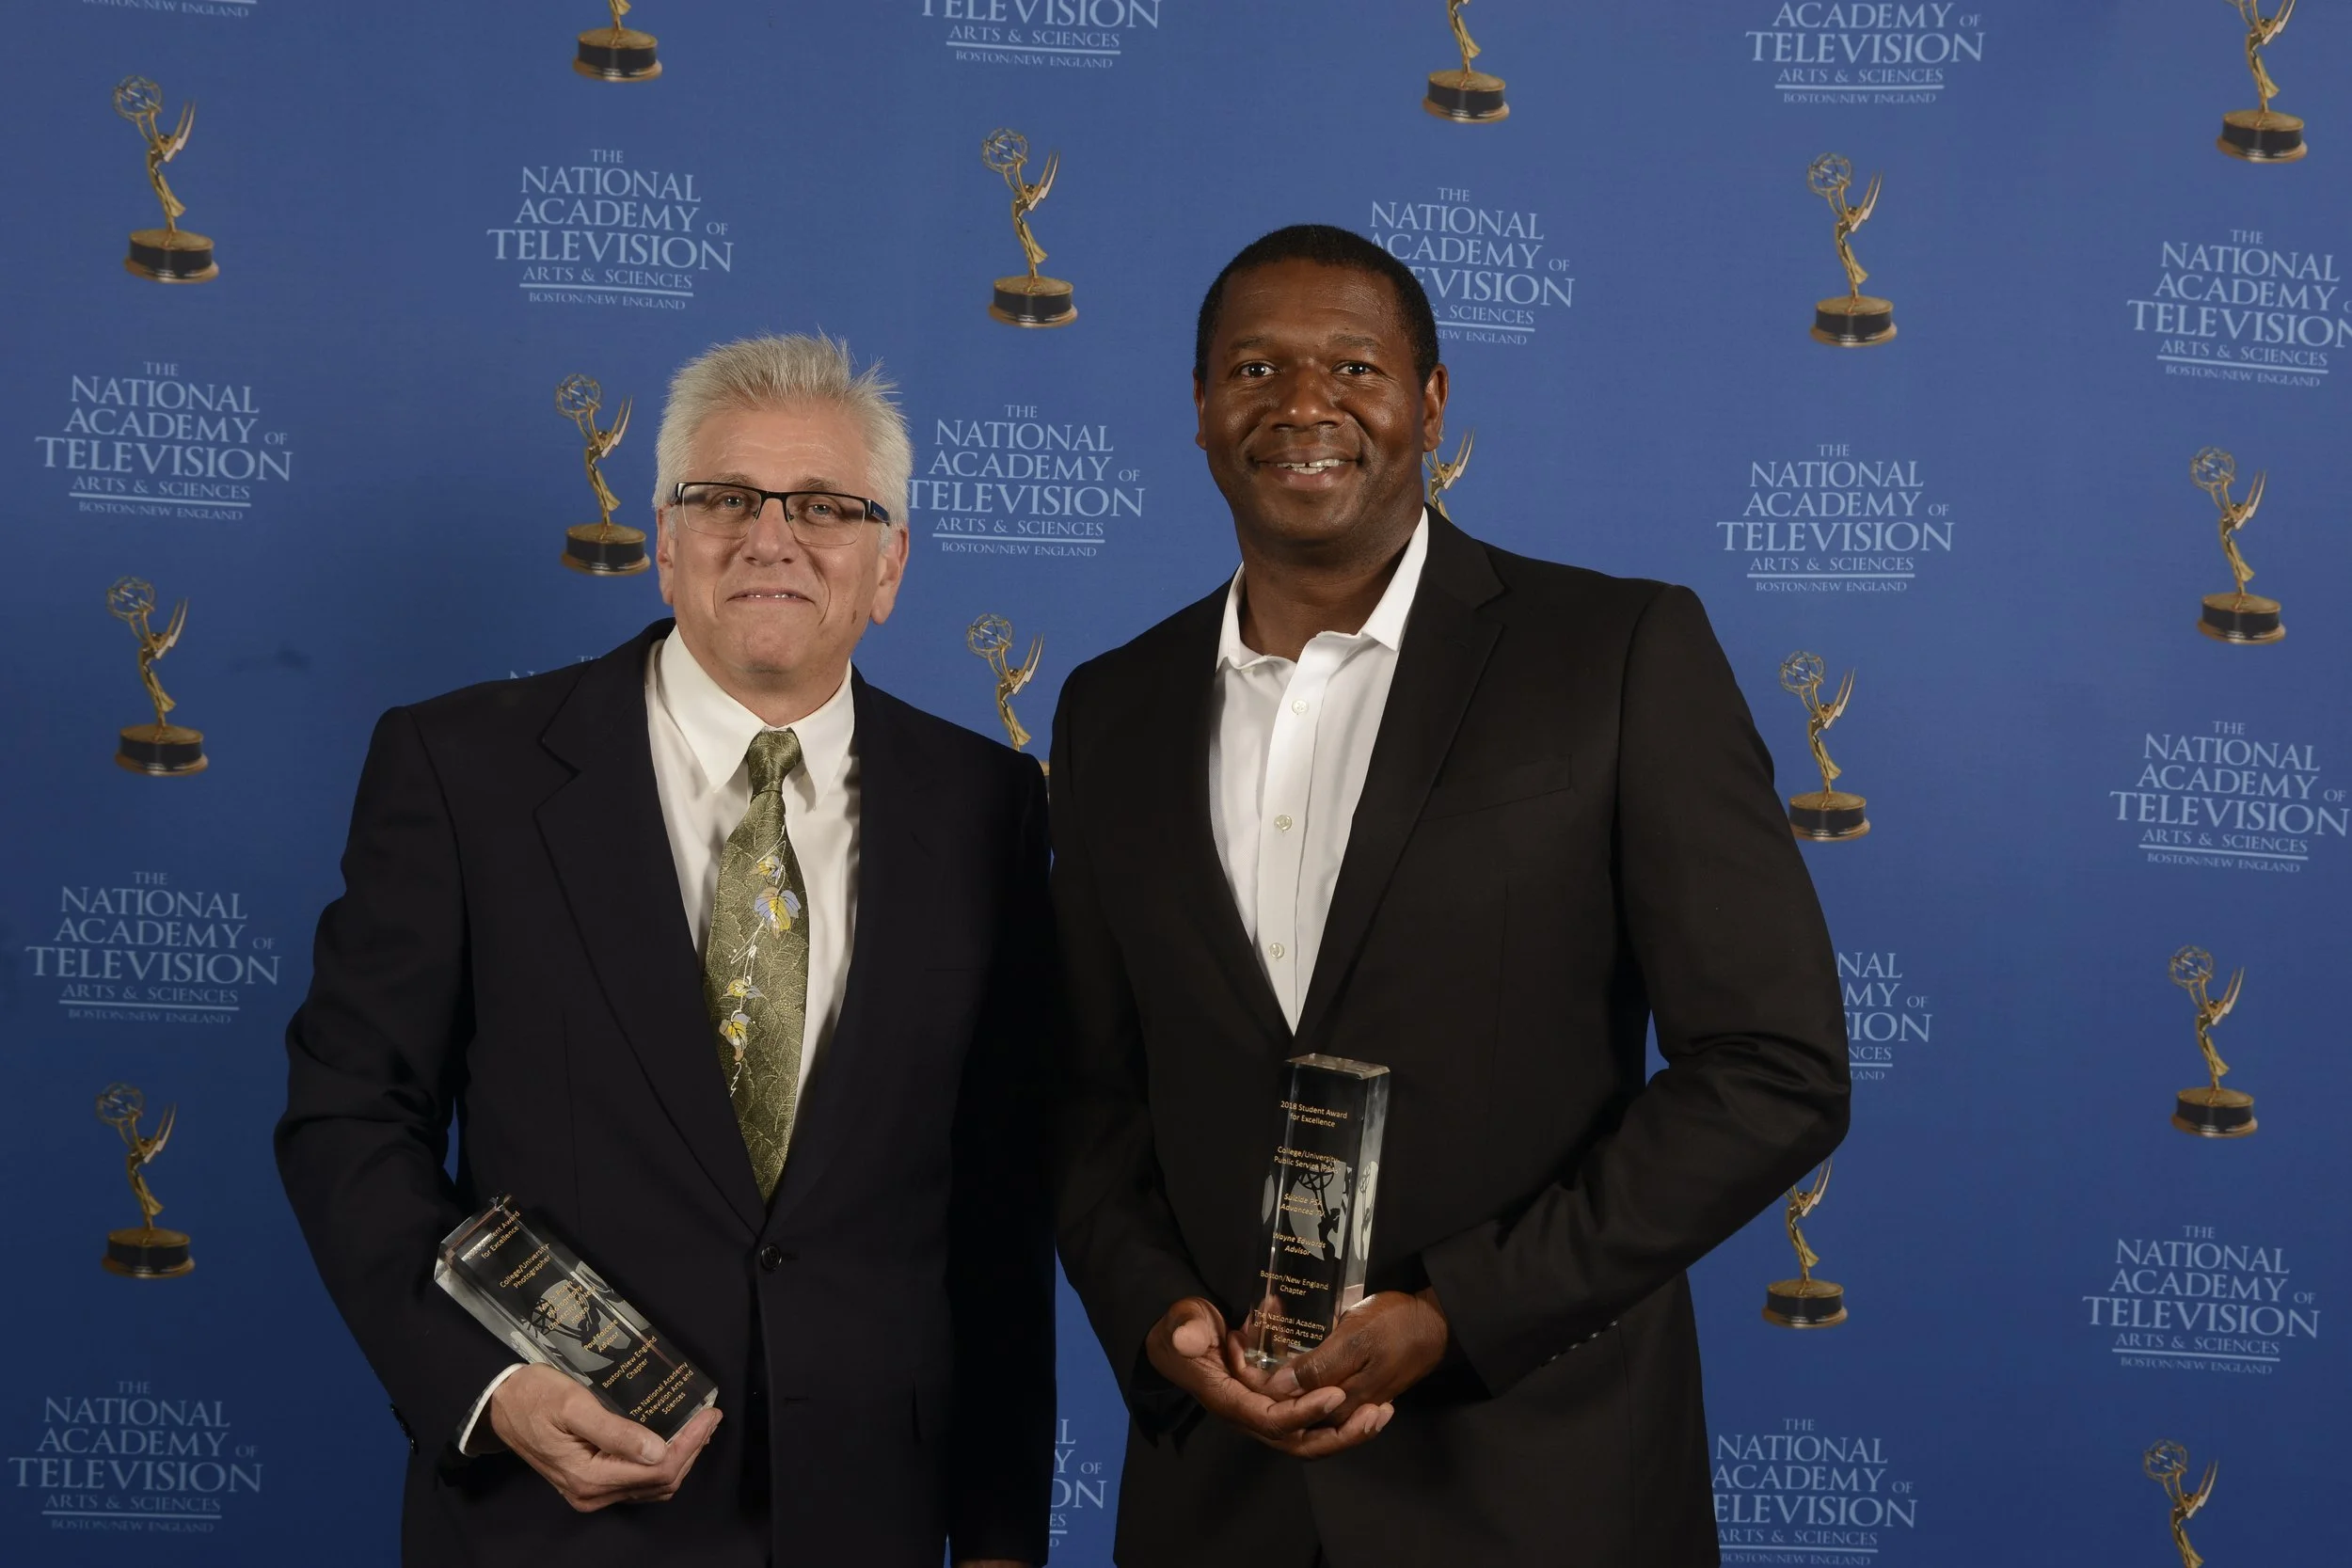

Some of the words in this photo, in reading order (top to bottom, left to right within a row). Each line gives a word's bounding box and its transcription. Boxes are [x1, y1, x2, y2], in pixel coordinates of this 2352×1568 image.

[1772, 2, 1953, 28] ACADEMY
[950, 25, 1000, 40] ARTS
[1033, 30, 1120, 47] SCIENCES
[1746, 32, 1983, 63] TELEVISION
[957, 51, 1043, 64] BOSTON/NEW
[1050, 56, 1112, 68] ENGLAND
[1778, 69, 1827, 82] ARTS
[1859, 69, 1943, 83] SCIENCES
[591, 150, 623, 163] THE
[521, 166, 701, 201] NATIONAL
[1438, 188, 1469, 201] THE
[515, 198, 698, 231] ACADEMY
[707, 223, 727, 235] OF
[1370, 201, 1544, 239] NATIONAL
[2231, 230, 2262, 244] THE
[487, 230, 734, 272] TELEVISION
[2161, 241, 2340, 281] NATIONAL
[1549, 260, 1568, 271] OF
[523, 267, 573, 280] ARTS
[581, 269, 595, 282] &
[606, 269, 691, 288] SCIENCES
[530, 293, 617, 304] BOSTON/NEW
[623, 296, 685, 309] ENGLAND
[2154, 273, 2337, 310] ACADEMY
[1450, 305, 1534, 324] SCIENCES
[1467, 331, 1527, 344] ENGLAND
[2160, 340, 2209, 356] ARTS
[2241, 346, 2328, 366] SCIENCES
[144, 361, 177, 376] THE
[2166, 365, 2252, 380] BOSTON/NEW
[2258, 372, 2320, 387] ENGLAND
[72, 375, 259, 413] NATIONAL
[1005, 405, 1037, 418] THE
[64, 408, 258, 443] ACADEMY
[264, 433, 287, 445] OF
[935, 420, 1114, 451] NATIONAL
[36, 436, 293, 481] TELEVISION
[1818, 444, 1851, 456] THE
[929, 451, 1112, 481] ACADEMY
[1119, 470, 1139, 482] OF
[1750, 461, 1923, 487] NATIONAL
[73, 476, 125, 491] ARTS
[159, 482, 249, 499] SCIENCES
[908, 480, 1145, 516] TELEVISION
[79, 501, 171, 515] BOSTON/NEW
[177, 508, 243, 519] ENGLAND
[1743, 492, 1921, 516] ACADEMY
[1929, 504, 1948, 515] OF
[936, 517, 985, 531] ARTS
[993, 520, 1008, 532] &
[1018, 521, 1104, 536] SCIENCES
[1717, 522, 1954, 551] TELEVISION
[942, 542, 1029, 554] BOSTON/NEW
[1035, 546, 1097, 556] ENGLAND
[1751, 558, 1799, 570] ARTS
[1830, 558, 1914, 570] SCIENCES
[1756, 582, 1841, 591] BOSTON/NEW
[1847, 582, 1907, 591] ENGLAND
[2213, 721, 2245, 734] THE
[2144, 734, 2320, 771] NATIONAL
[2136, 764, 2318, 800] ACADEMY
[2109, 791, 2350, 836] TELEVISION
[2142, 830, 2191, 843] ARTS
[2222, 834, 2307, 852] SCIENCES
[2148, 852, 2233, 867] BOSTON/NEW
[2239, 860, 2300, 872] ENGLAND
[62, 886, 246, 919] NATIONAL
[54, 918, 245, 948] ACADEMY
[25, 946, 280, 985] TELEVISION
[62, 984, 115, 997] ARTS
[149, 988, 237, 1003] SCIENCES
[1907, 995, 1929, 1008] OF
[1280, 1101, 1297, 1110] 2018
[1298, 1104, 1325, 1114] Student
[1326, 1110, 1347, 1118] Award
[1301, 1116, 1335, 1127] Excellence
[1274, 1156, 1295, 1164] Public
[1295, 1160, 1319, 1170] Service
[1284, 1194, 1308, 1203] Suicide
[501, 1211, 519, 1227] Award
[482, 1249, 491, 1259] for
[490, 1224, 518, 1251] Excellence
[1273, 1232, 1296, 1242] Wayne
[1296, 1236, 1326, 1247] Edwards
[2183, 1226, 2214, 1238] THE
[1284, 1245, 1310, 1255] Advisor
[2117, 1239, 2289, 1274] NATIONAL
[513, 1254, 551, 1289] Photographer
[1260, 1271, 1300, 1284] Boston/New
[1302, 1279, 1328, 1290] England
[1279, 1285, 1306, 1295] Chapter
[2109, 1269, 2287, 1302] ACADEMY
[1253, 1309, 1266, 1319] The
[1266, 1312, 1295, 1323] National
[1295, 1319, 1327, 1331] Academy
[2083, 1296, 2320, 1338] TELEVISION
[597, 1331, 619, 1351] Advisor
[1273, 1334, 1300, 1345] Sciences
[2116, 1334, 2164, 1347] ARTS
[2195, 1338, 2279, 1354] SCIENCES
[602, 1355, 637, 1387] Boston/New
[634, 1336, 658, 1357] England
[626, 1358, 649, 1380] Chapter
[2121, 1357, 2205, 1370] BOSTON/NEW
[2211, 1362, 2272, 1373] ENGLAND
[629, 1404, 643, 1417] The
[640, 1384, 664, 1406] National
[662, 1361, 688, 1386] Academy
[639, 1412, 648, 1422] of
[644, 1390, 673, 1416] Television
[671, 1380, 683, 1391] Arts
[681, 1370, 693, 1381] and
[45, 1398, 230, 1427] NATIONAL
[661, 1391, 686, 1414] Sciences
[1783, 1418, 1815, 1430] THE
[38, 1428, 228, 1456] ACADEMY
[1716, 1435, 1887, 1464] NATIONAL
[8, 1458, 262, 1492] TELEVISION
[1081, 1462, 1102, 1475] OF
[1712, 1465, 1885, 1492] ACADEMY
[1892, 1482, 1912, 1494] OF
[1713, 1494, 1917, 1528] ELEVISION
[1795, 1531, 1877, 1545] SCIENCES
